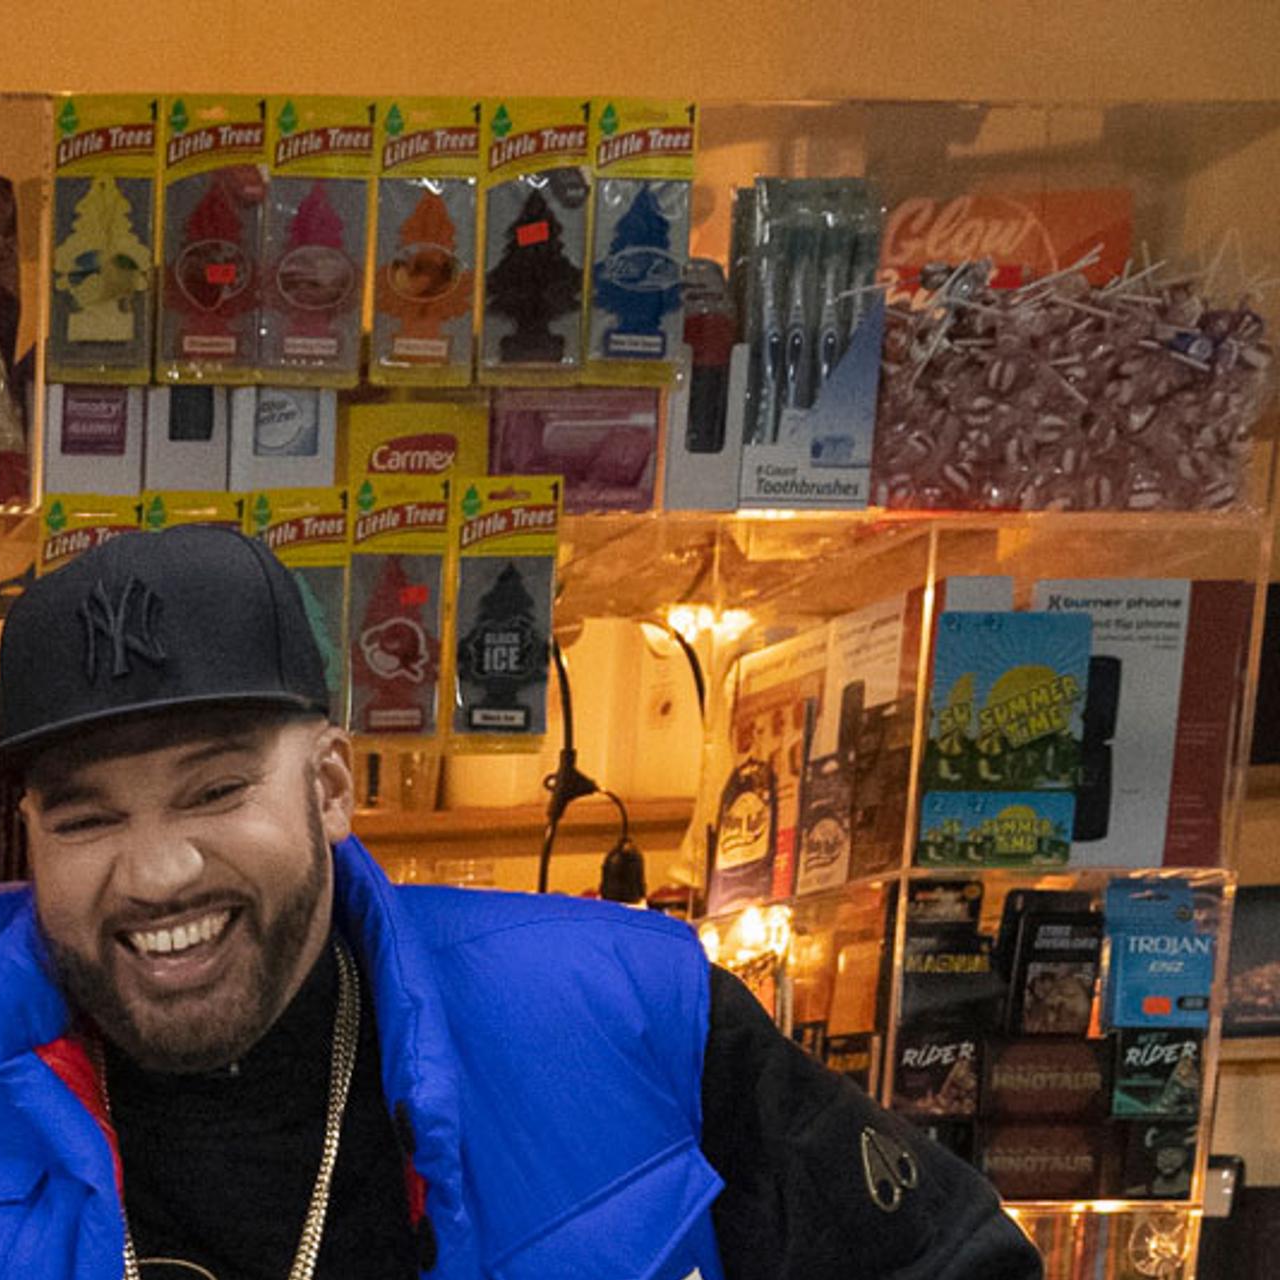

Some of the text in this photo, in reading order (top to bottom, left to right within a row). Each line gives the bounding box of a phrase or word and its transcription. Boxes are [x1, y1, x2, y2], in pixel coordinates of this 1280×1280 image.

[151, 100, 157, 121] 1
[259, 100, 266, 121] 1
[369, 103, 376, 124] 1
[473, 103, 480, 123] 1
[583, 102, 589, 122] 1
[687, 103, 694, 123] 1
[59, 126, 153, 164] Little Trees
[168, 125, 262, 163] Little Trees
[277, 128, 371, 163] Little Trees
[384, 129, 477, 167] Little Trees
[492, 129, 585, 166] Little Trees
[599, 129, 690, 166] Little Trees
[371, 445, 455, 471] Carmex
[756, 477, 859, 496] Toothbrushes
[303, 517, 345, 538] Trees
[357, 505, 446, 539] Little Trees
[460, 509, 556, 545] Little Trees
[46, 534, 90, 560] Little
[1126, 597, 1182, 614] phone
[483, 646, 521, 671] ICE
[1128, 935, 1213, 954] TROJAN
[905, 954, 989, 973] MAGNUM
[902, 1042, 975, 1067] RIDER
[1125, 1041, 1198, 1067] RIDER
